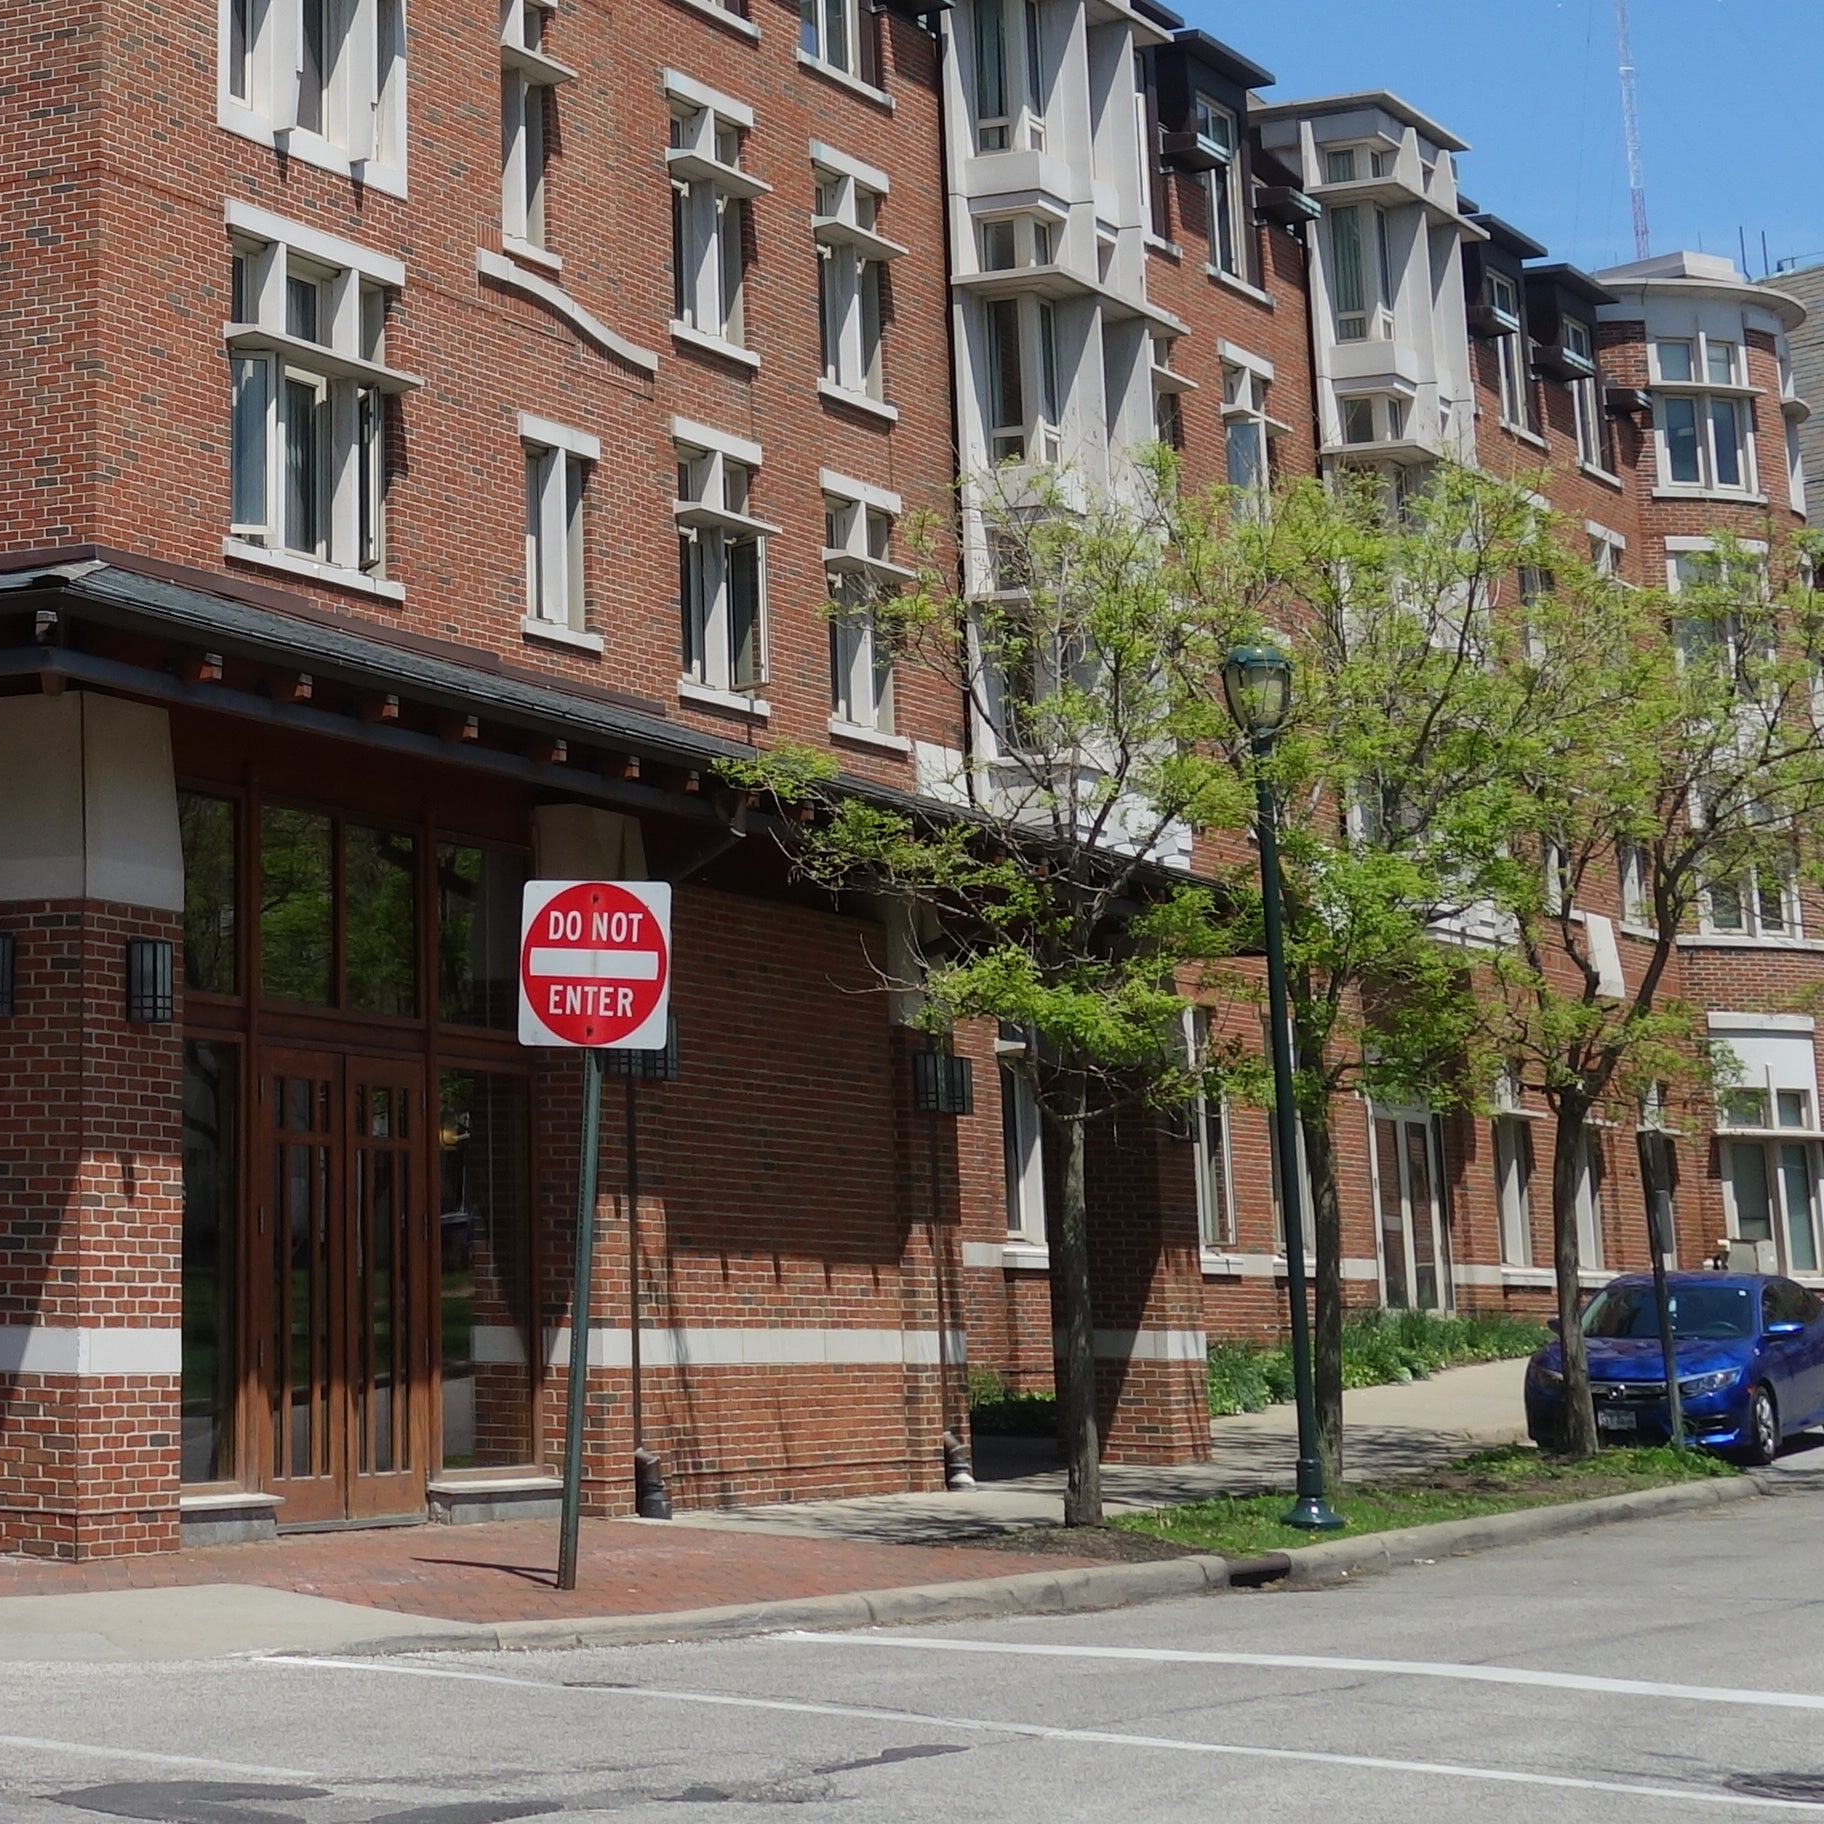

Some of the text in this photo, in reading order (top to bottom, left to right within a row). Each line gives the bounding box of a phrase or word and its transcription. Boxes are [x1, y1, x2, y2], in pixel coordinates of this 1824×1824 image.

[548, 910, 643, 943] DO NOT
[548, 984, 634, 1018] ENTER
